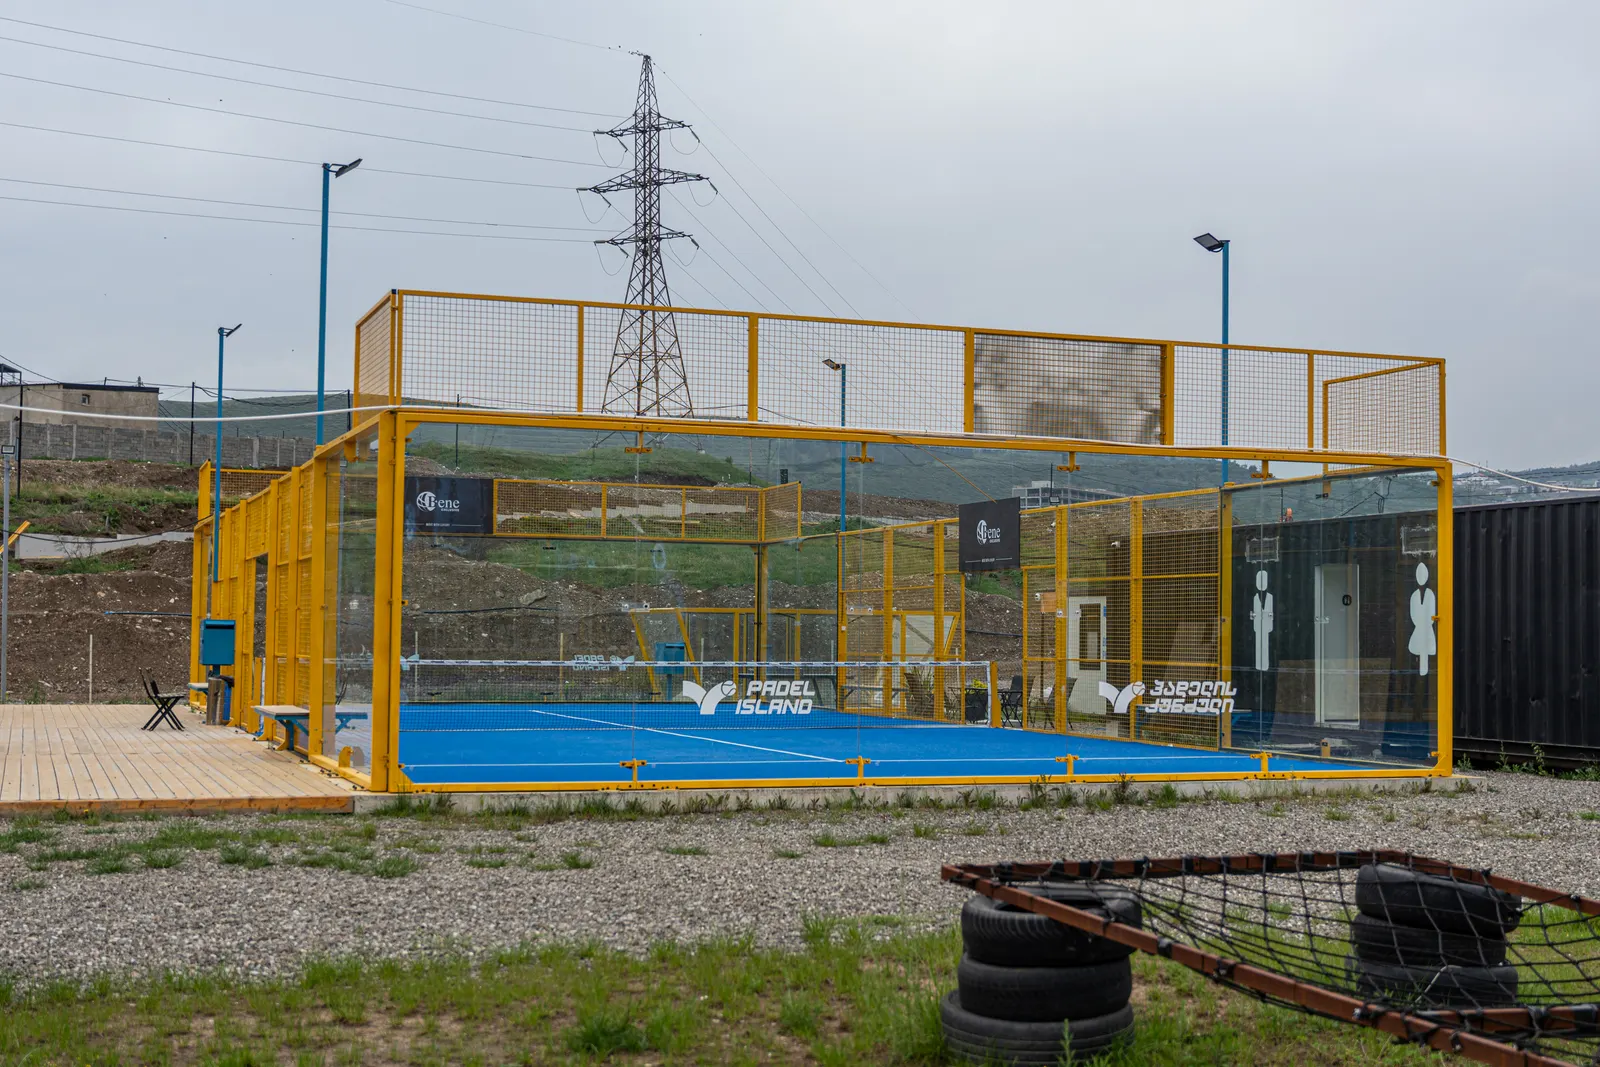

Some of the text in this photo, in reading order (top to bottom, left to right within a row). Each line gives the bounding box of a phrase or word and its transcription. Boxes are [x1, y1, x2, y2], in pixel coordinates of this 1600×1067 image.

[746, 680, 816, 697] PADEL
[1149, 679, 1237, 697] პადელის
[735, 698, 813, 715] ISLAND
[1144, 698, 1235, 715] კუნძული
